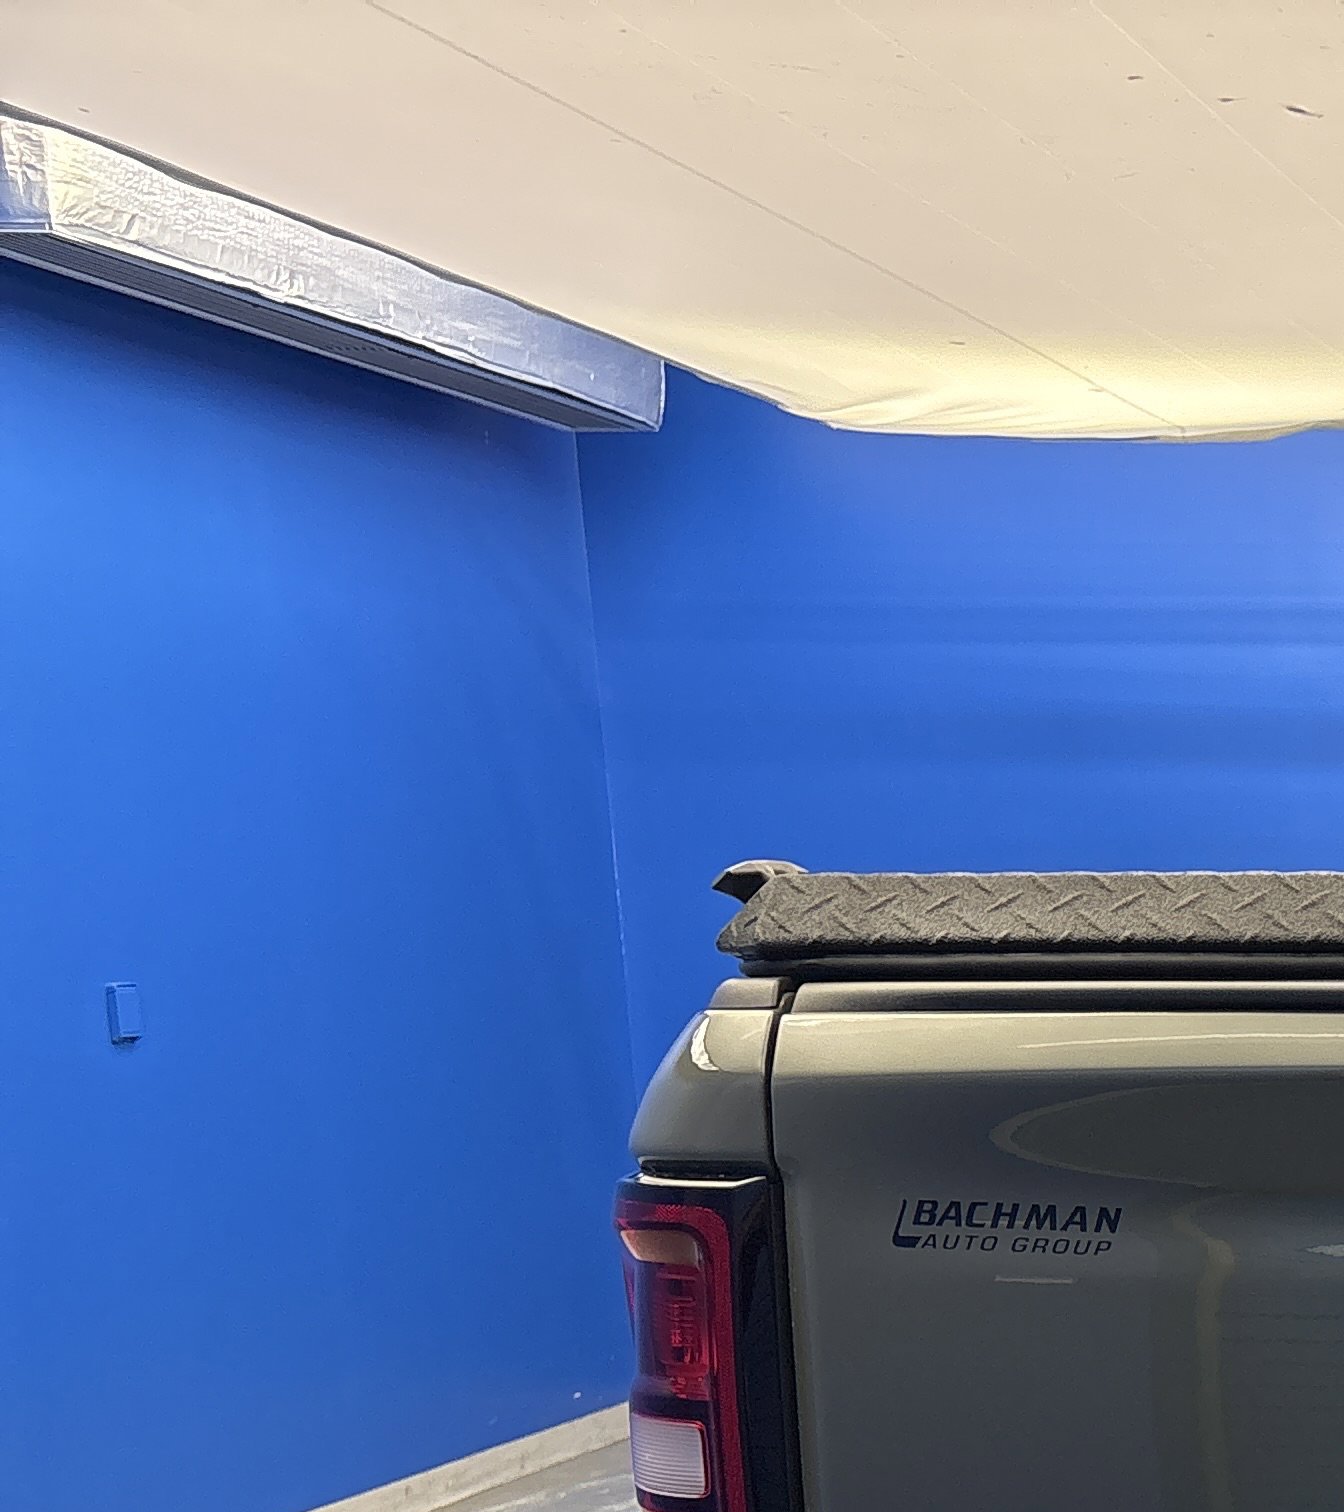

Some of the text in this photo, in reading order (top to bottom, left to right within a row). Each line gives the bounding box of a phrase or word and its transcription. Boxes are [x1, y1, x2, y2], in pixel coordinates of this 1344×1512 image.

[912, 1199, 1122, 1234] BACHMAN
[921, 1233, 1112, 1256] AUTO GROUP
